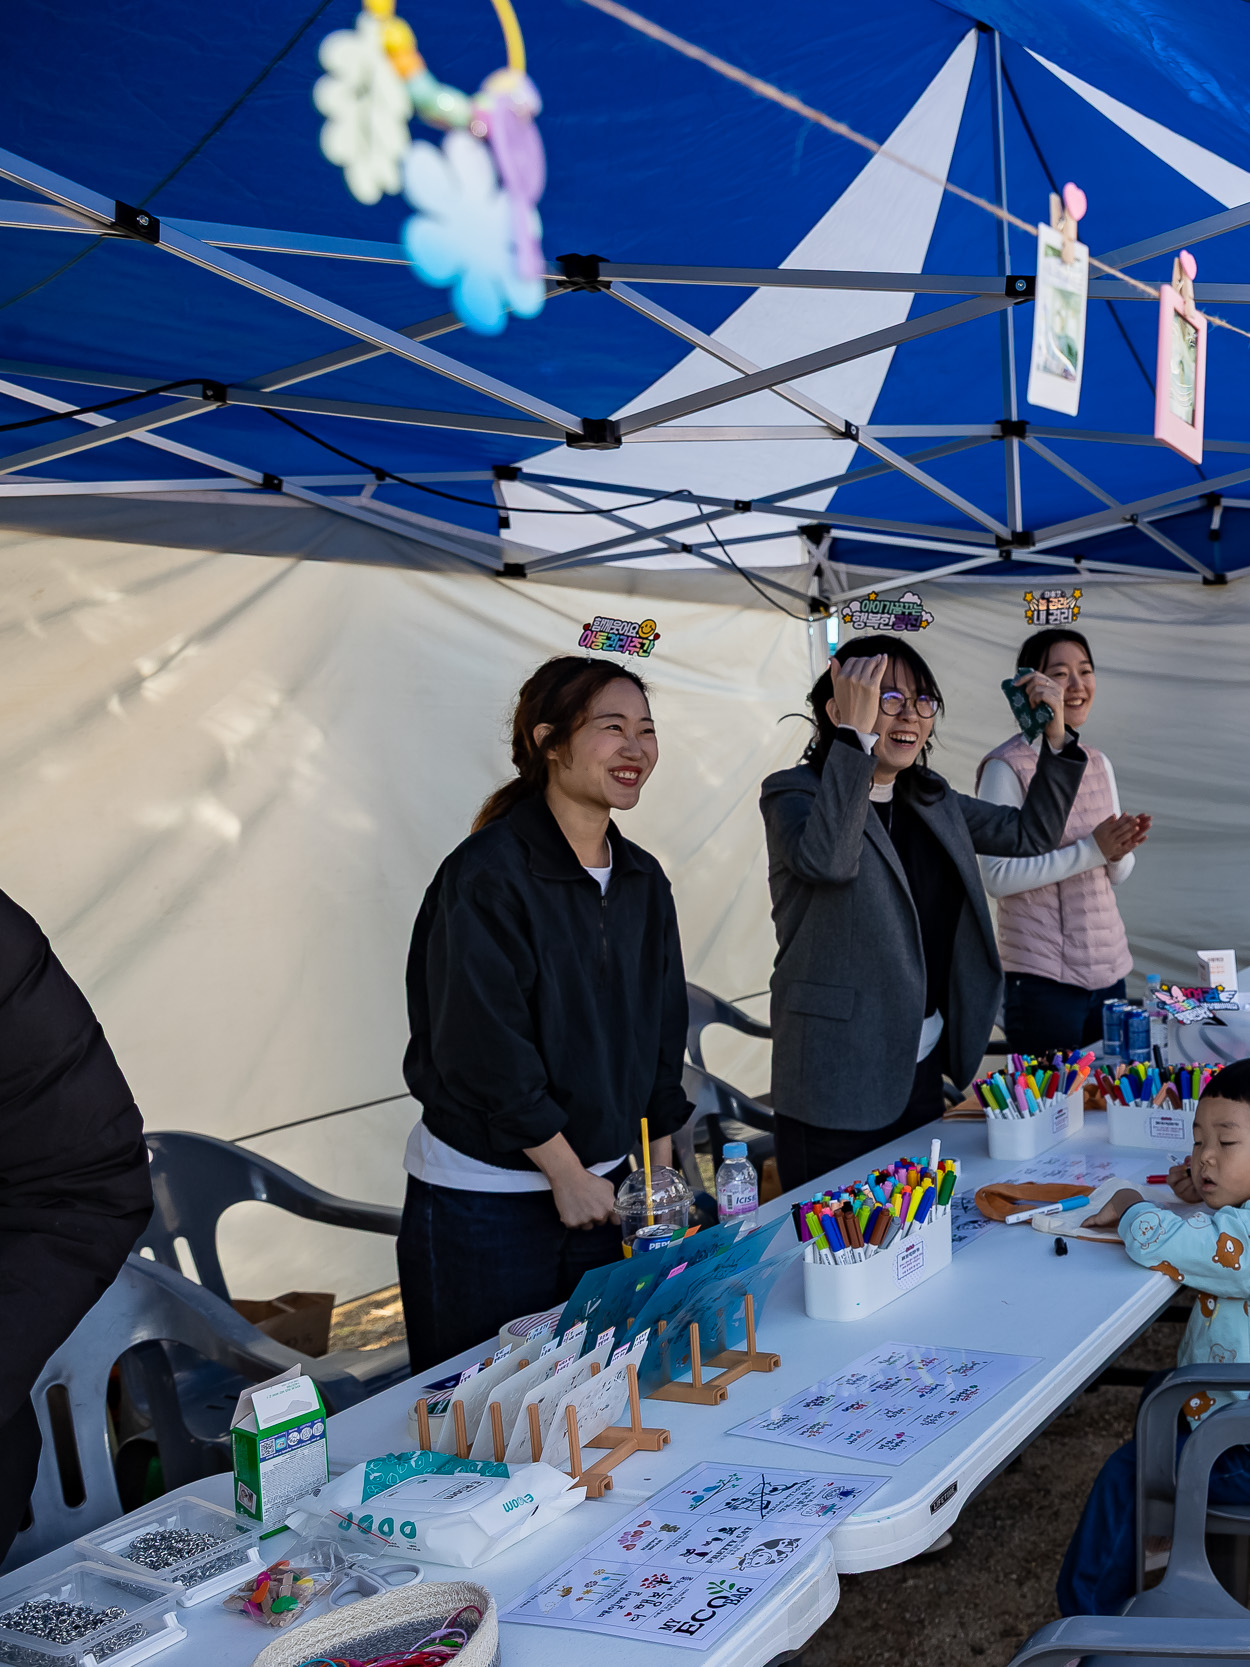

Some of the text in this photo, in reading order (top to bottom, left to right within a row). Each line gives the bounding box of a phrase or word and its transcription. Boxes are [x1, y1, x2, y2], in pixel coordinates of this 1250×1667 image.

[579, 630, 656, 657] 아동권리주간
[704, 1538, 739, 1564] PRETTY
[735, 1526, 754, 1538] CAT
[724, 1586, 754, 1606] BAG
[657, 1617, 682, 1631] MY
[671, 1593, 737, 1636] ECO
